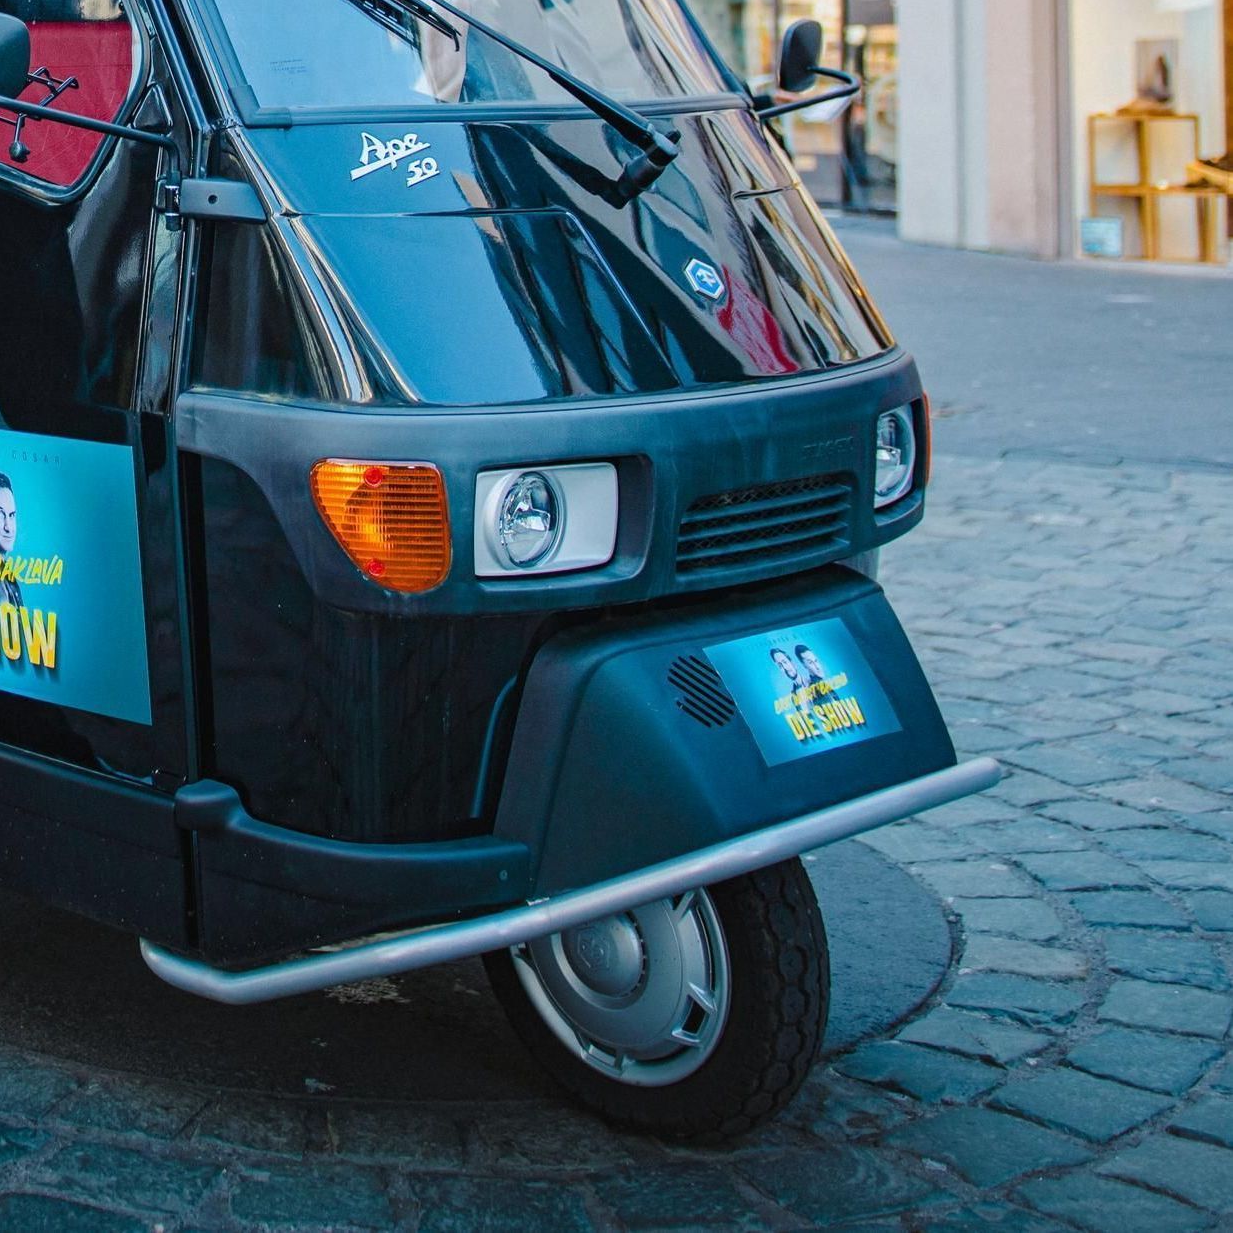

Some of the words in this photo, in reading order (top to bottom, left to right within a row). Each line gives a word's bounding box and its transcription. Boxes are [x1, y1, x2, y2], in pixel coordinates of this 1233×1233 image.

[352, 132, 430, 177] Ape
[406, 157, 440, 186] 50
[785, 710, 821, 741] DIE
[813, 696, 865, 732] SHOW
